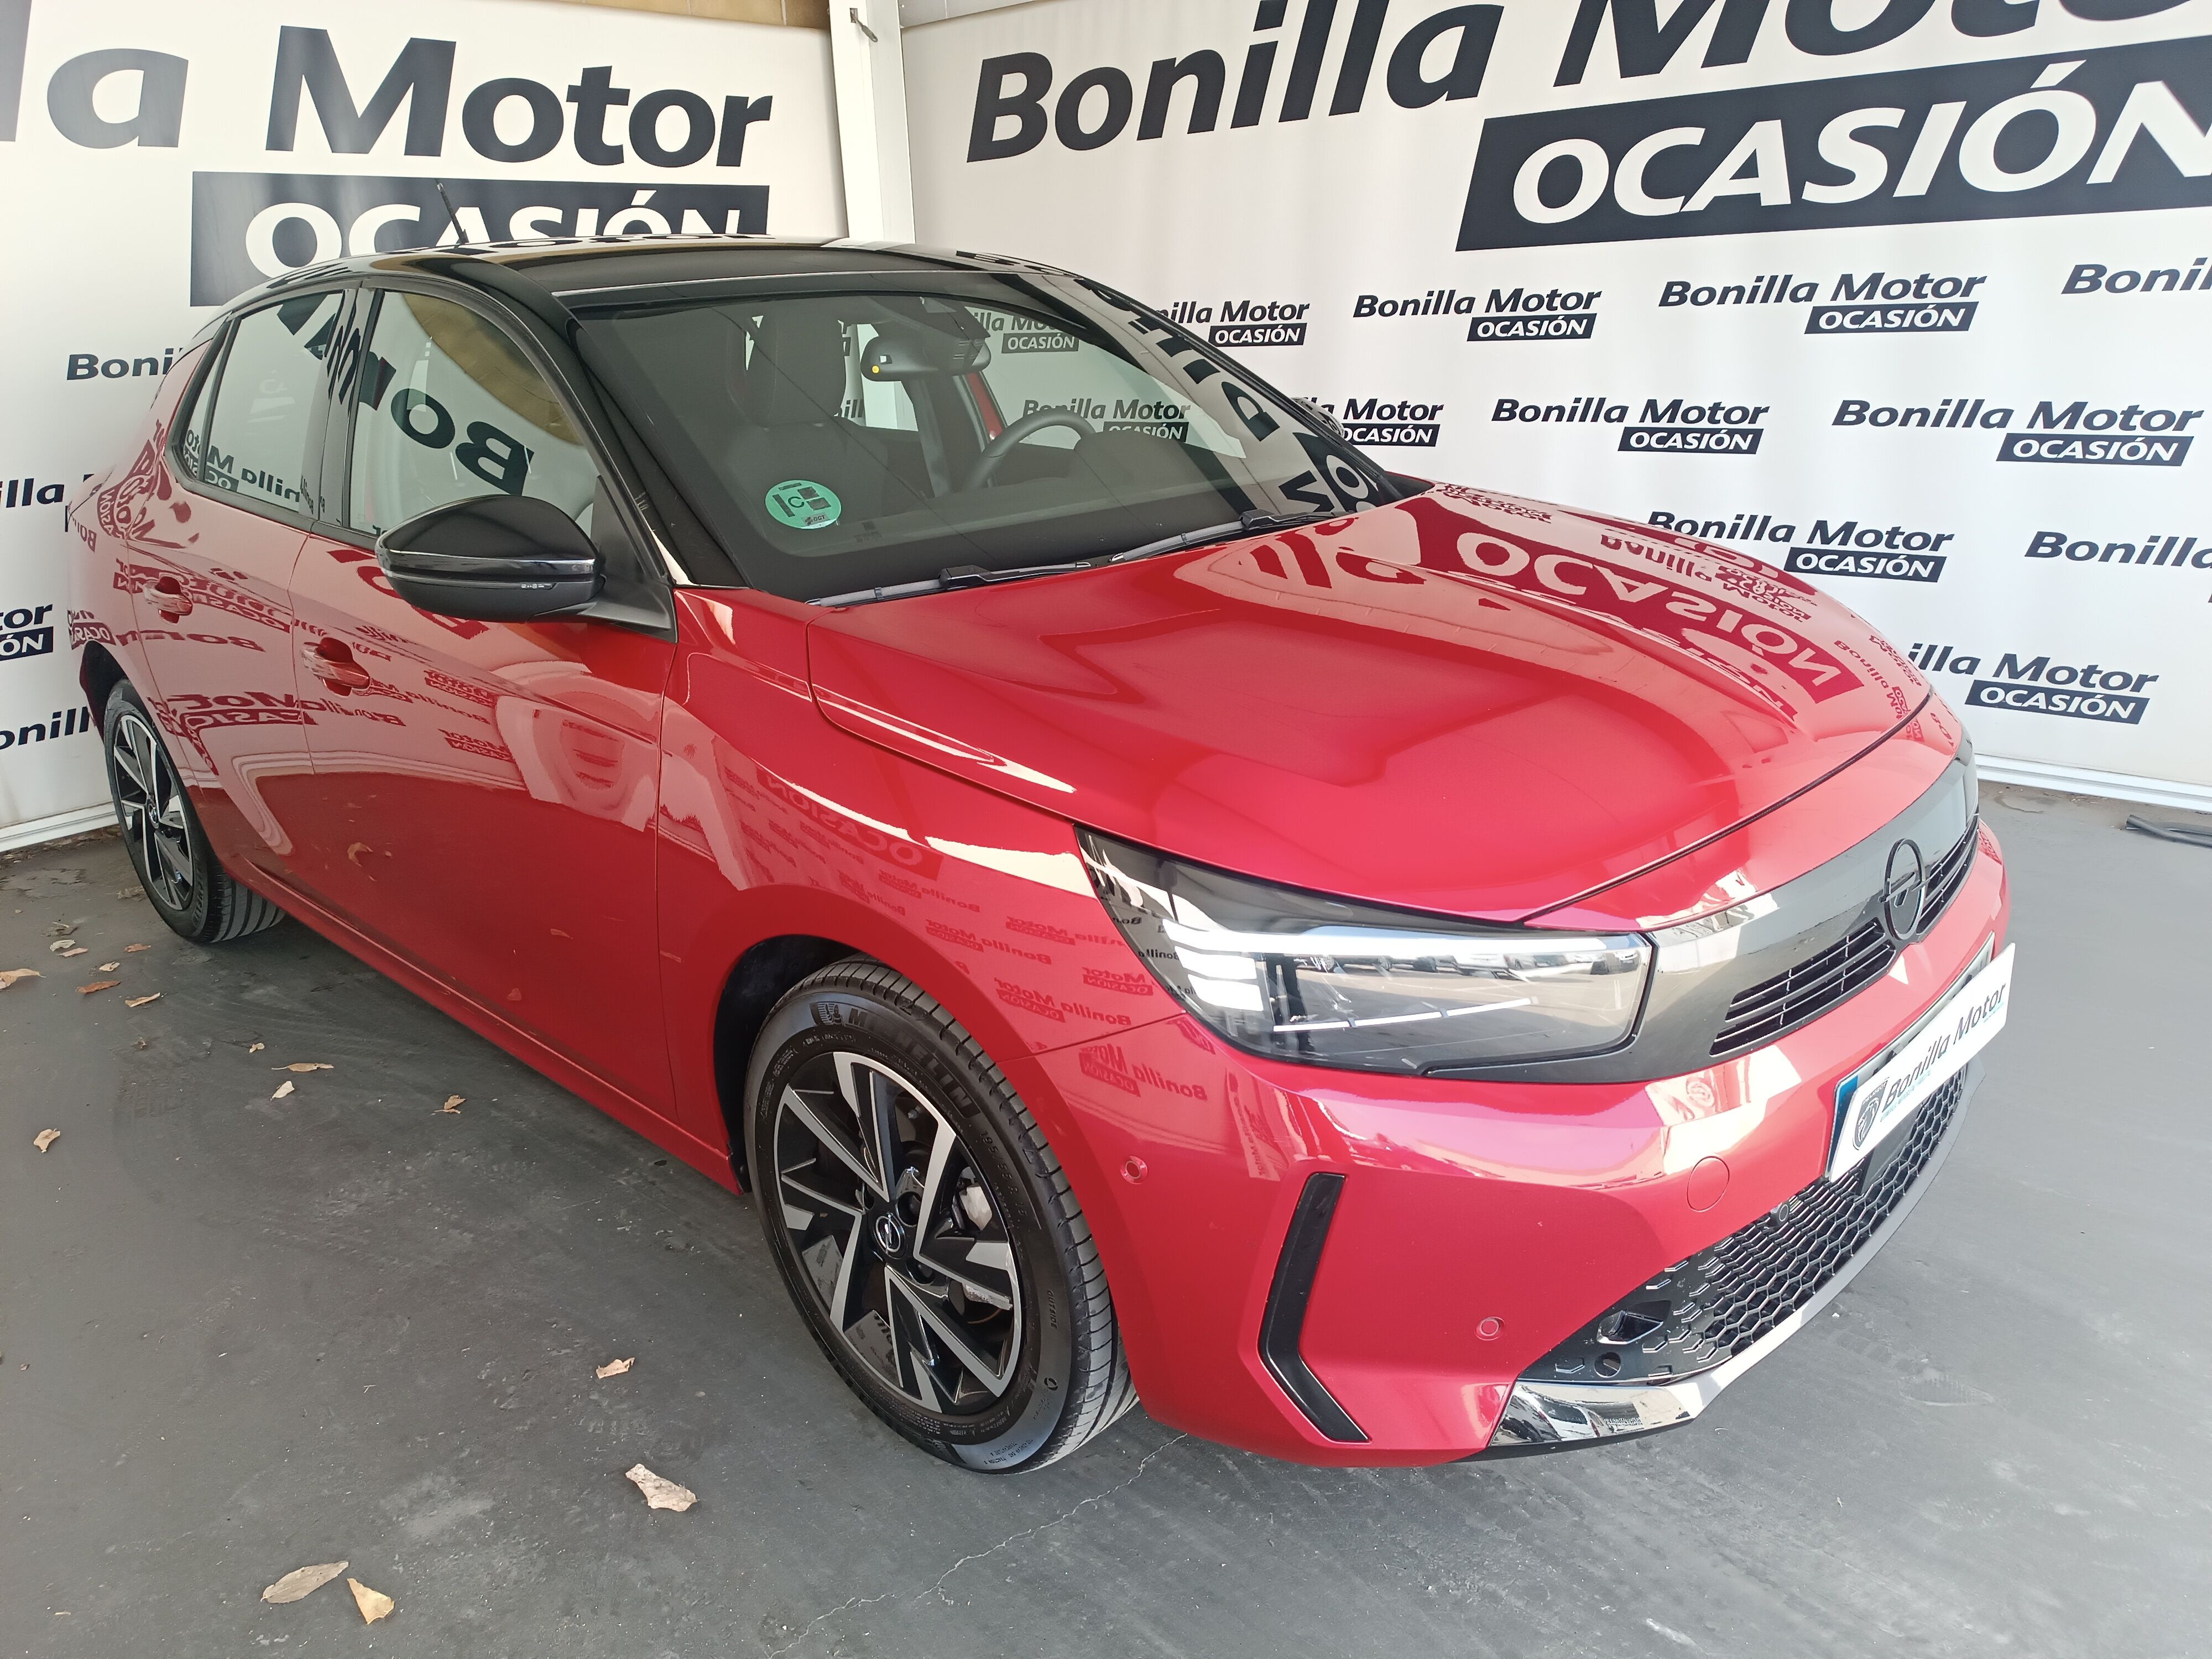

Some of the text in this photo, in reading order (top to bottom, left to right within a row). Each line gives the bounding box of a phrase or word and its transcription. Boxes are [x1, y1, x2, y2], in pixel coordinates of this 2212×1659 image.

[966, 0, 1504, 163] Bonilla
[265, 25, 773, 168] Motor
[1512, 59, 2212, 224] OCASIÓN
[1353, 288, 1602, 317] Bonilla Motor
[1658, 273, 1987, 307] Bonilla Motor
[1219, 300, 1310, 322] Motor
[1819, 305, 1966, 331] OCASIÓN
[1008, 333, 1075, 350] OCASIÓN
[1215, 325, 1301, 344] OCASIÓN
[1477, 318, 1588, 337] OCASIÓN
[67, 348, 183, 380] Boni
[1023, 398, 1191, 420] Billa Motor
[1343, 398, 1444, 421] Motor
[1491, 398, 1770, 427] Bonilla Motor
[1832, 399, 2204, 431] Bonilla Motor
[1109, 424, 1183, 439] SIÓN
[1343, 425, 1433, 443] OCASIÓN
[1629, 429, 1754, 451] OCASIÓN
[2013, 434, 2179, 462] OCASIÓN
[0, 478, 64, 508] lla
[1648, 512, 1954, 552] Bonilla Motor
[1797, 553, 1934, 578] OCASIÓN
[0, 604, 53, 630] or
[1992, 653, 2159, 692] Motor
[1980, 687, 2136, 719] OCASIÓN
[848, 1007, 973, 1109] MIHELIN
[1881, 1035, 1951, 1113] Bonilla
[1953, 983, 2006, 1045] Motor
